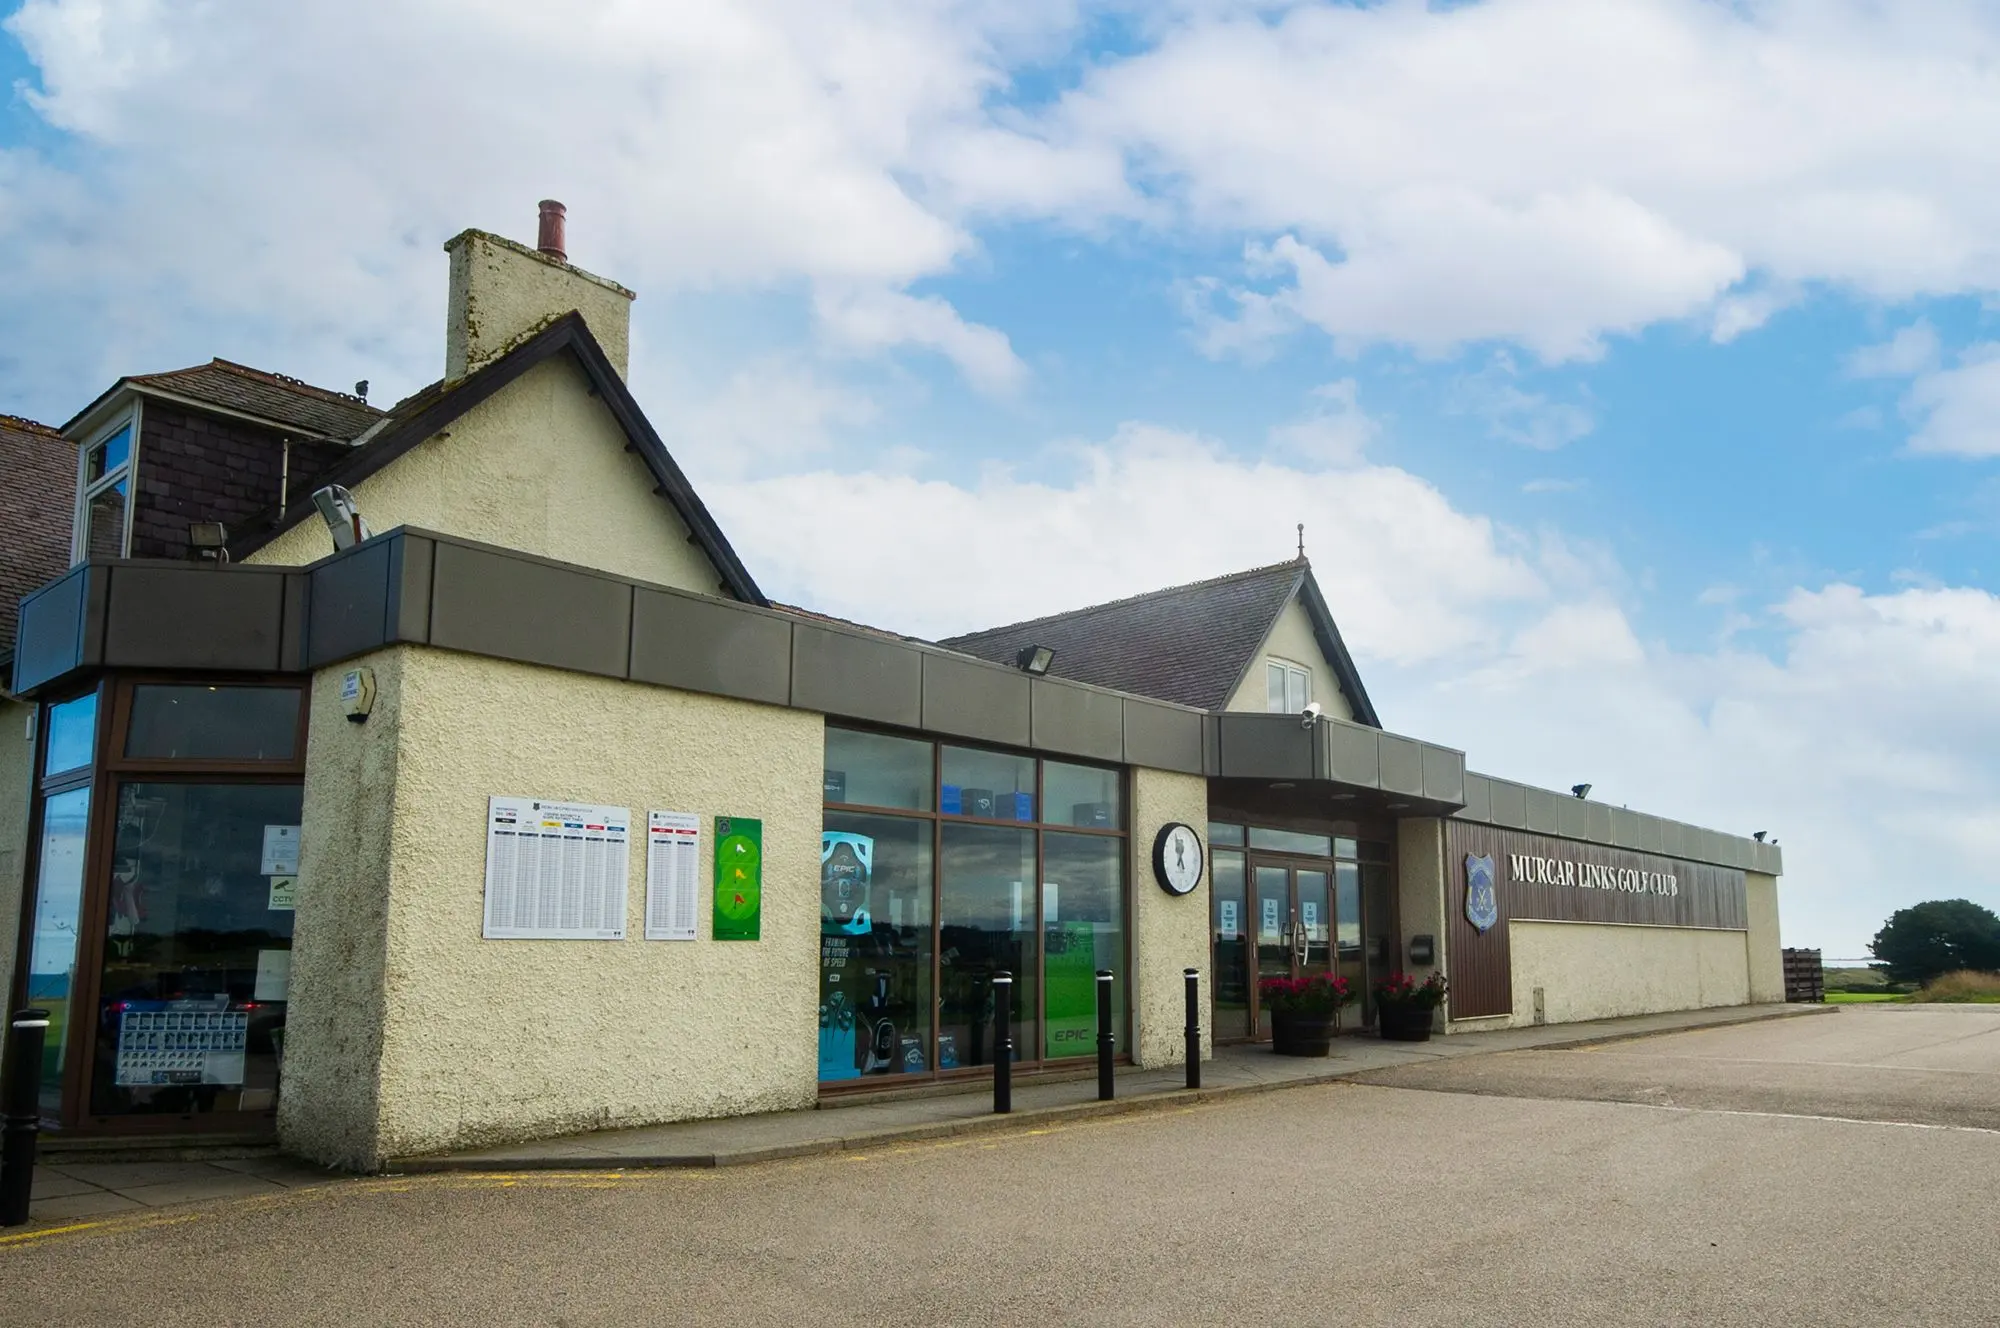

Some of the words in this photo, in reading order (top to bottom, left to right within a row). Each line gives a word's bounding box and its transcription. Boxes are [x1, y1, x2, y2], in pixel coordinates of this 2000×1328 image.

[834, 864, 856, 873] EPIC
[1510, 854, 1575, 886] MURCAR
[1577, 862, 1616, 890] LINKS
[1617, 868, 1649, 893] GOLF
[1650, 873, 1678, 896] CLUB
[272, 895, 294, 903] CCTV
[1054, 1028, 1090, 1042] EPIC
